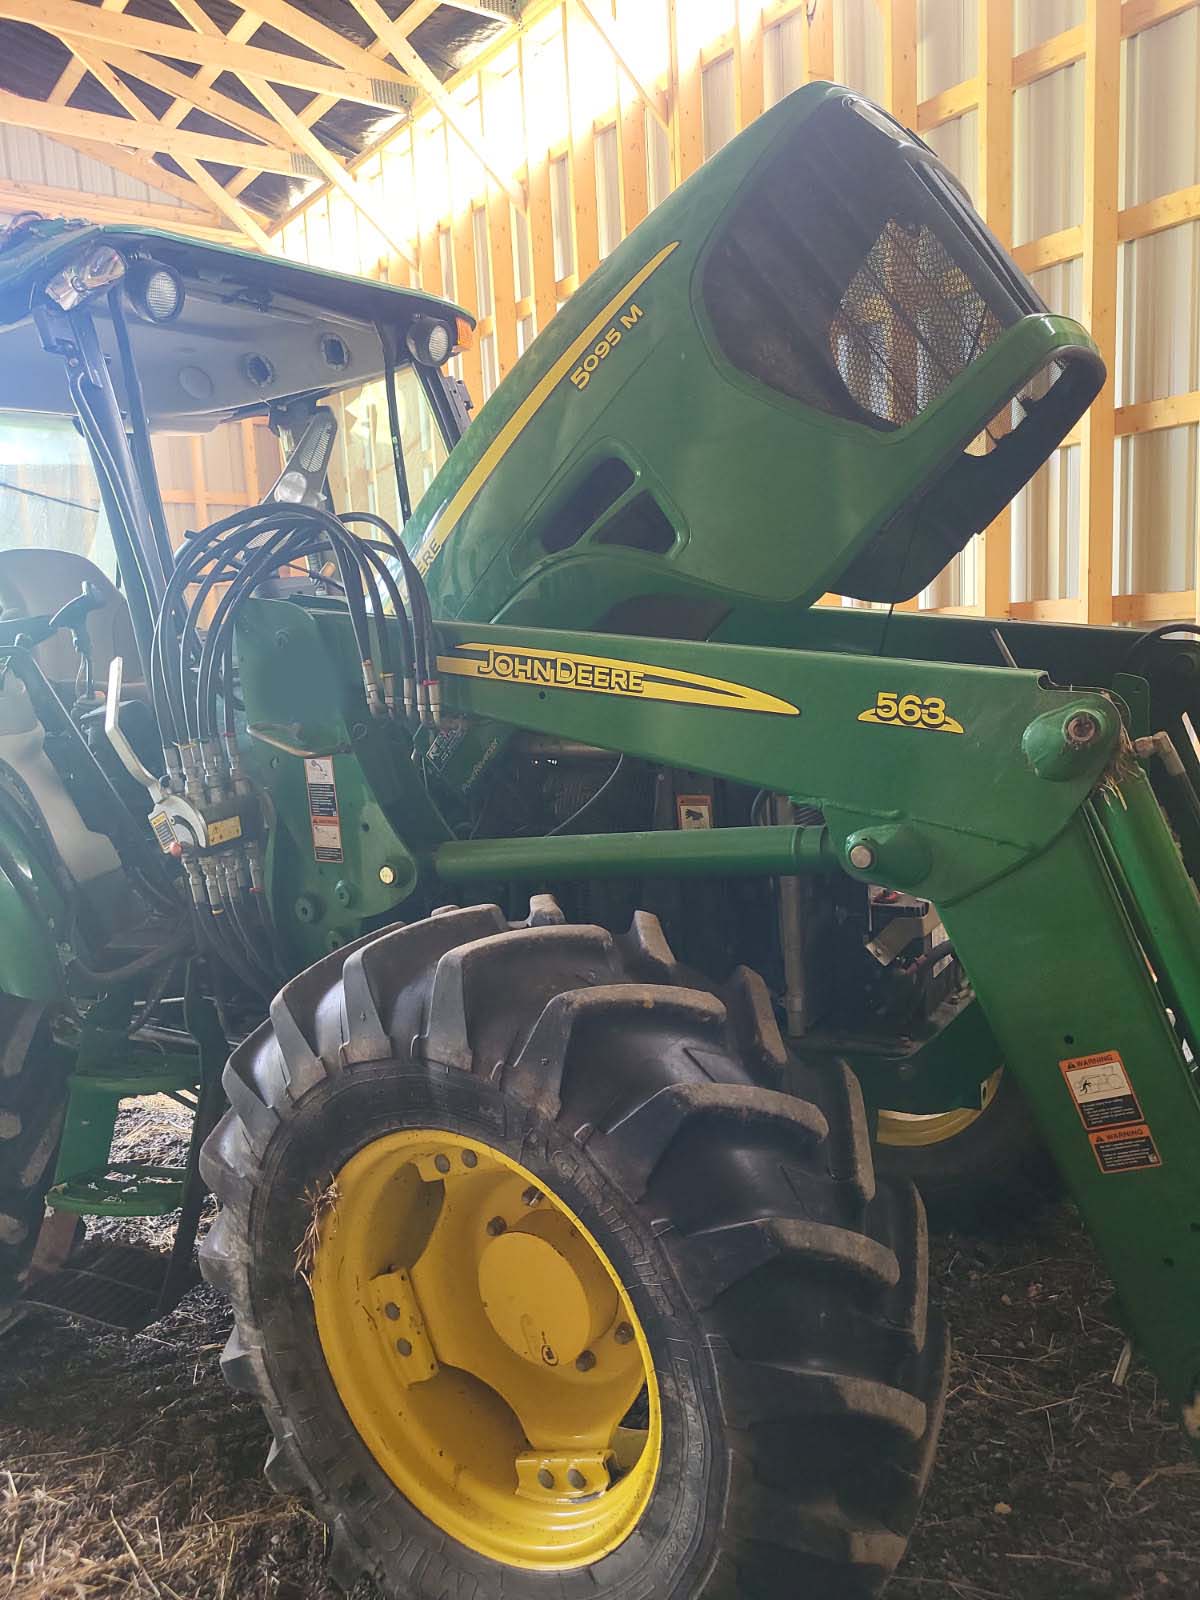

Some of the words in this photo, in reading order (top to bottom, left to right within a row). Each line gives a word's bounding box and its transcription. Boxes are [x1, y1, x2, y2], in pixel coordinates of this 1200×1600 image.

[570, 327, 622, 390] 5095
[620, 303, 643, 329] M
[415, 537, 441, 576] ERE
[478, 649, 550, 683] JOHN
[555, 657, 645, 693] DEERE
[876, 691, 946, 726] 563
[1077, 1054, 1113, 1068] WARNING
[1106, 1129, 1144, 1141] WARNING
